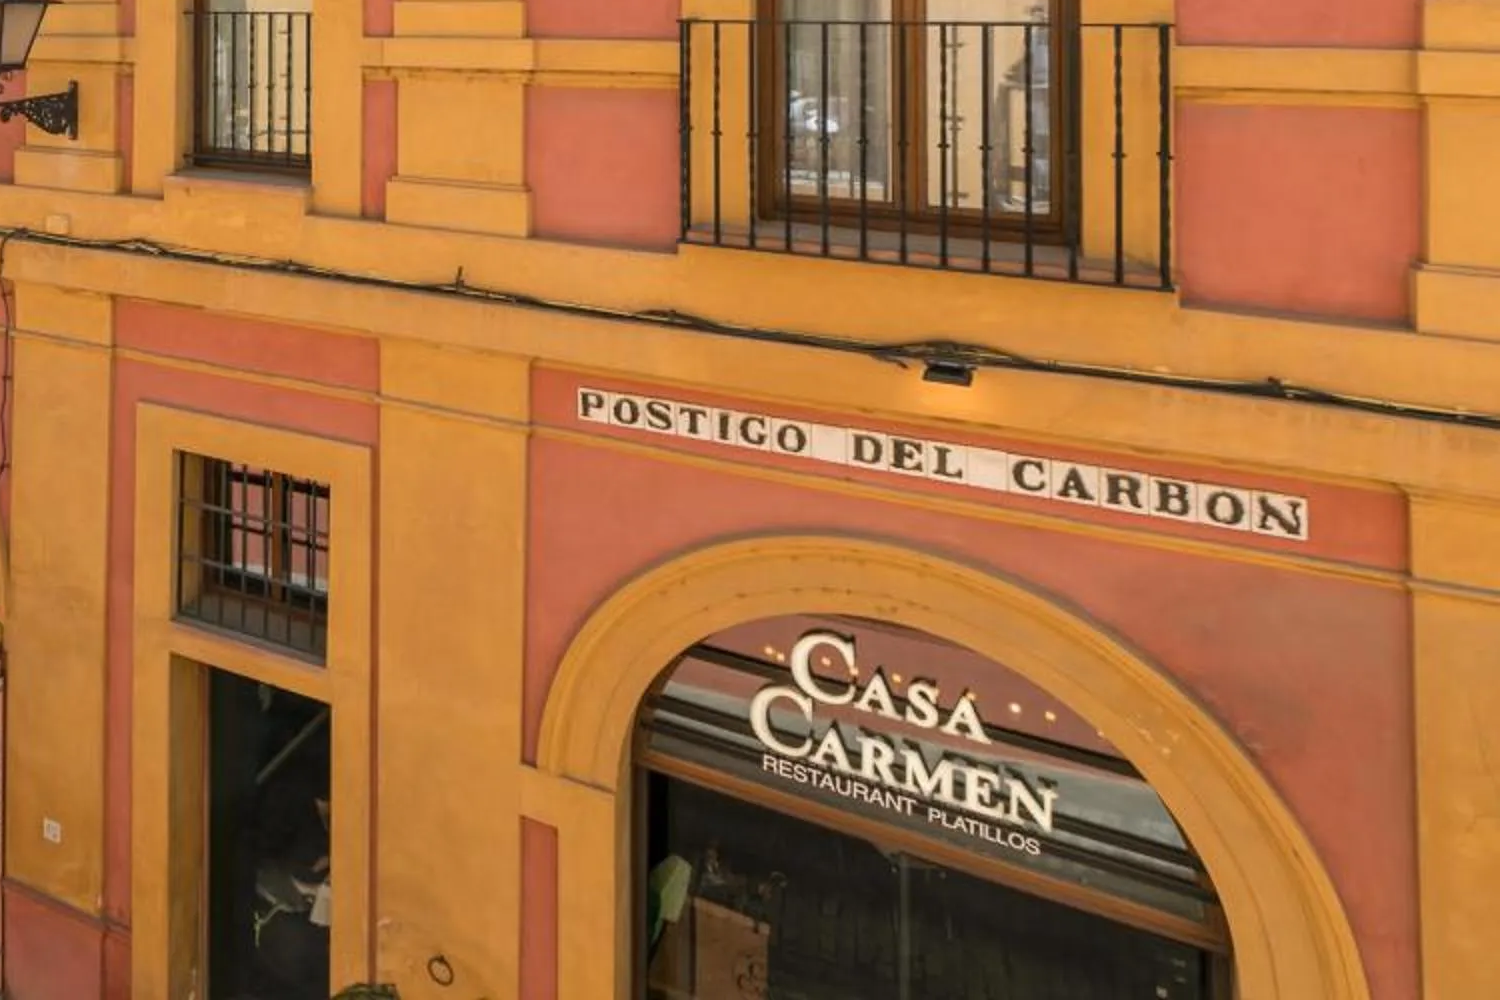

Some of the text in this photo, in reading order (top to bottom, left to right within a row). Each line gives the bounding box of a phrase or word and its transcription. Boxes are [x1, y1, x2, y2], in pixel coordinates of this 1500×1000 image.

[580, 391, 1302, 535] POSTIGO DEL CARBON
[791, 631, 992, 745] CASA
[750, 684, 1059, 833] CARMEN
[762, 753, 1041, 856] RESTAURANT PLATILLOS
